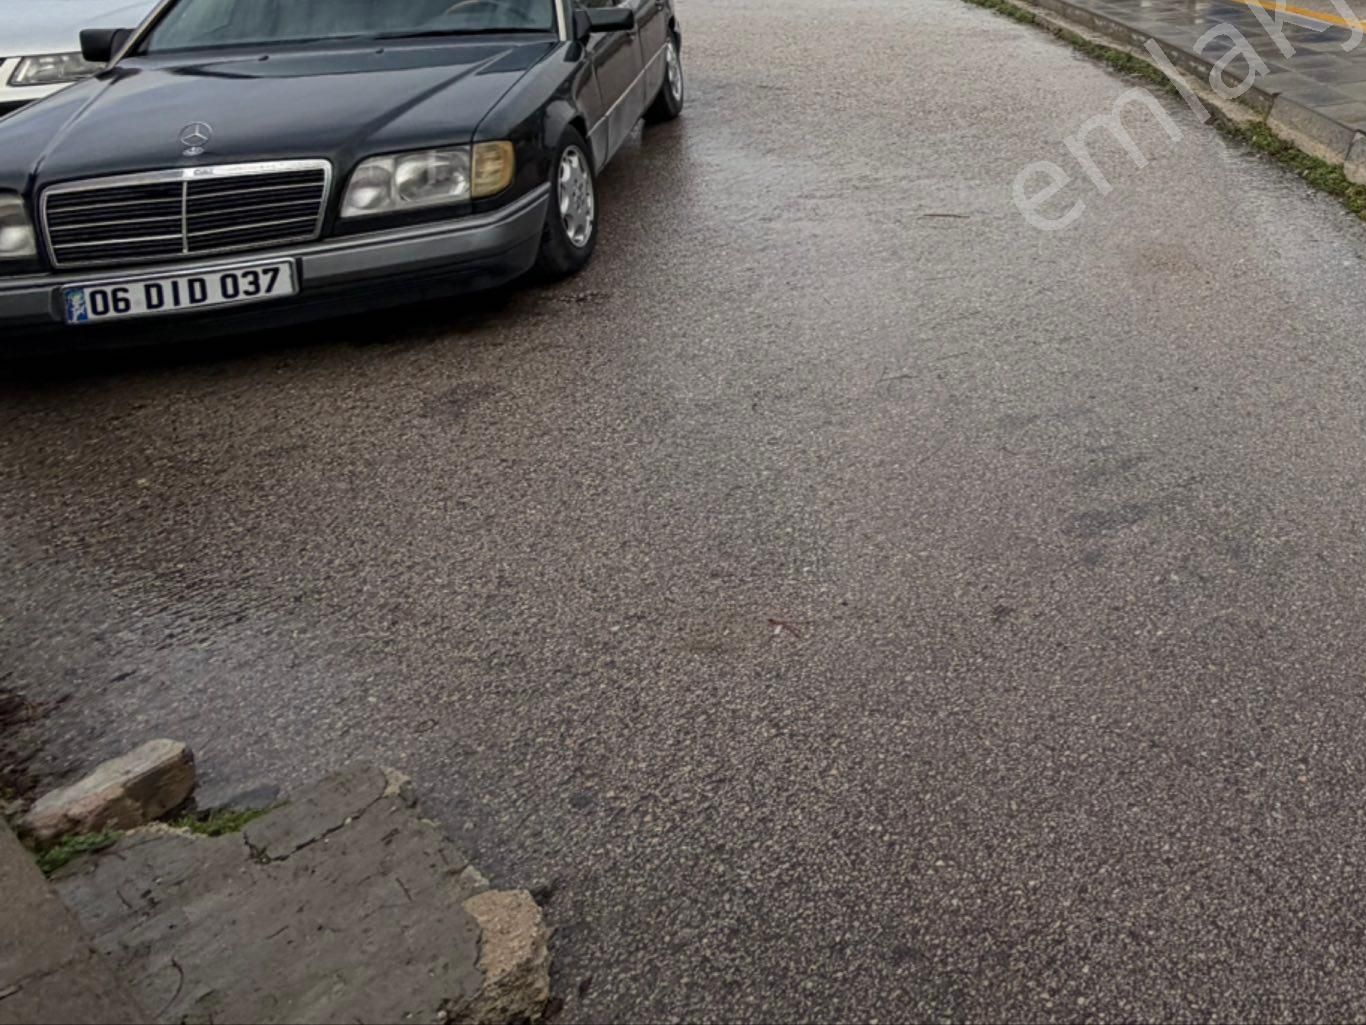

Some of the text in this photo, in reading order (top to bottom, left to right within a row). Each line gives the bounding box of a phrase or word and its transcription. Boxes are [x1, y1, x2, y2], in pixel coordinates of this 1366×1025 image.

[90, 267, 281, 316] 06 DID 037
